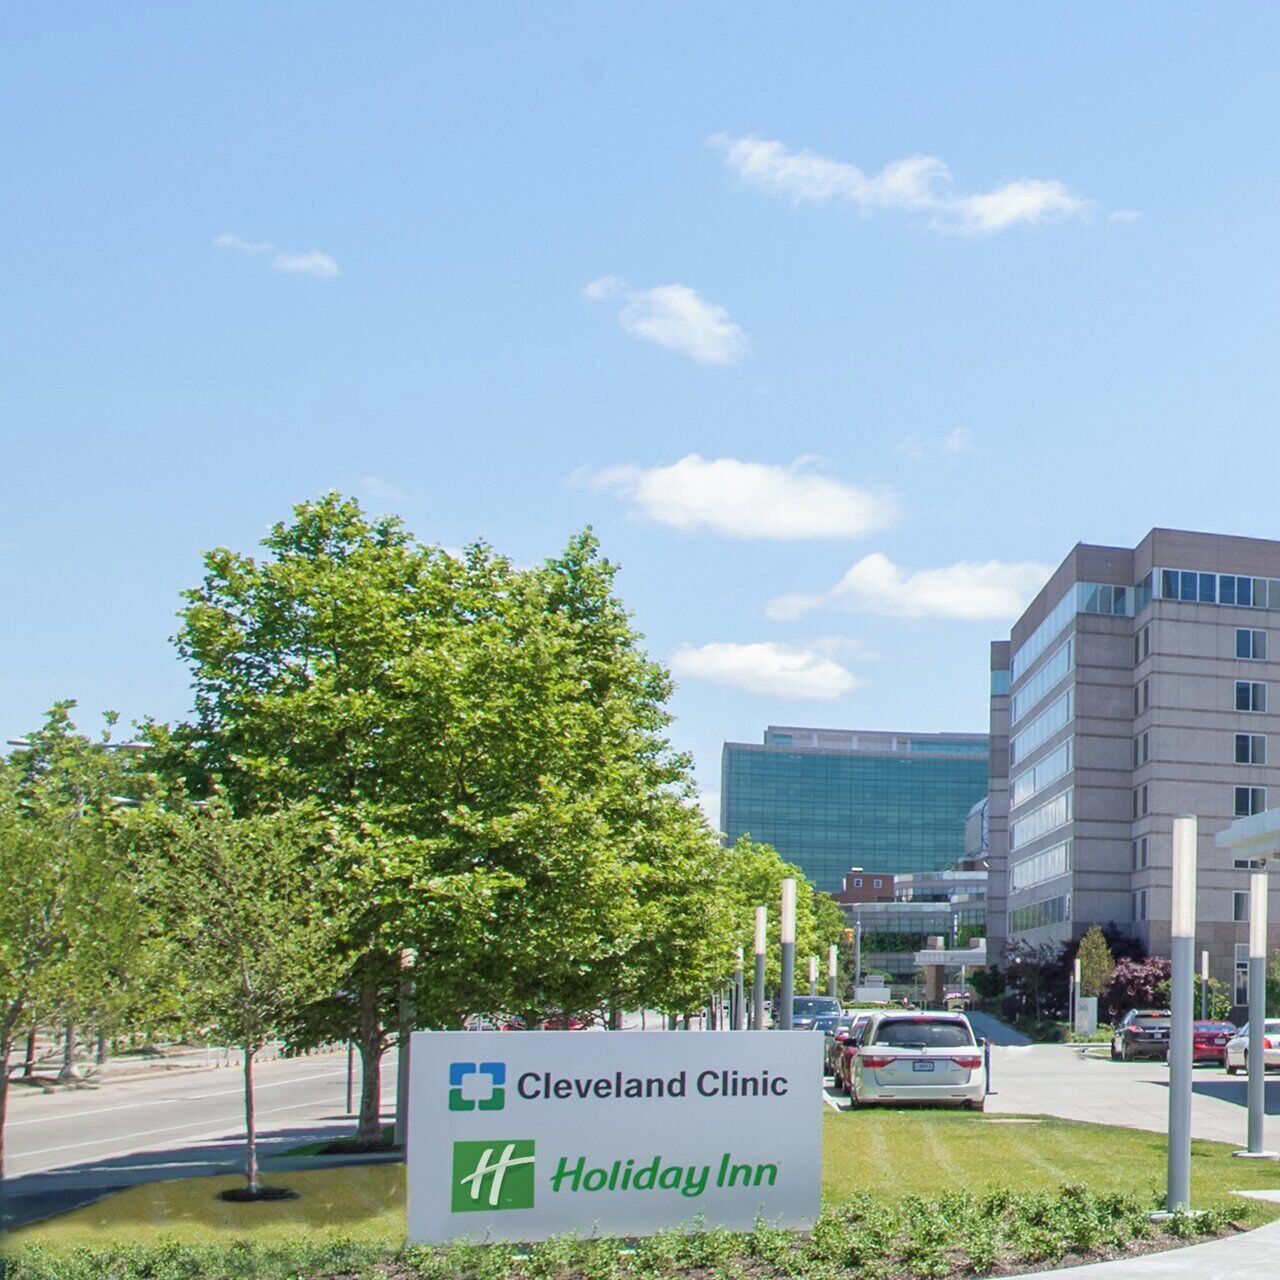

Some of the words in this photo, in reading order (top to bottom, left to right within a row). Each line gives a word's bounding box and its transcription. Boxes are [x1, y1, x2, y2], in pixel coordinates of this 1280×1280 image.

[516, 1071, 687, 1100] Cleveland
[696, 1070, 789, 1098] Clinic
[550, 1155, 709, 1198] Holiday
[716, 1152, 779, 1189] Inn
